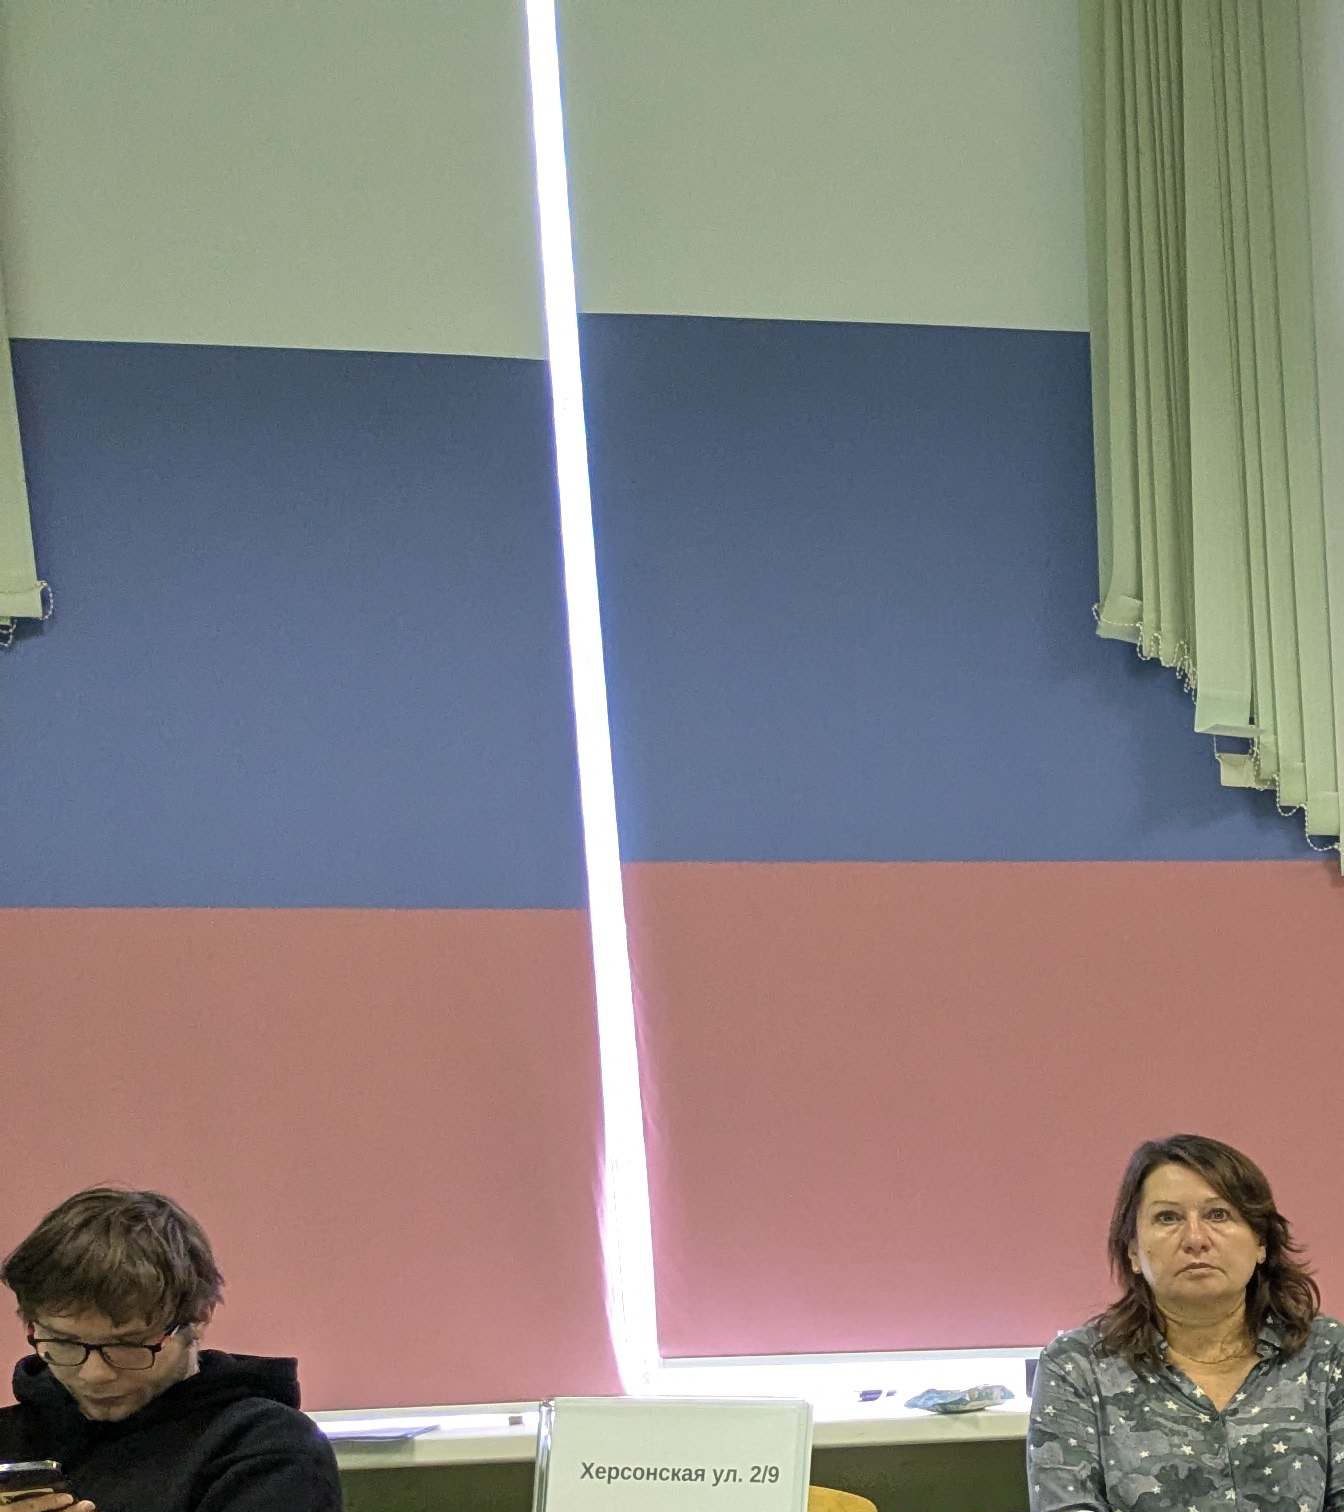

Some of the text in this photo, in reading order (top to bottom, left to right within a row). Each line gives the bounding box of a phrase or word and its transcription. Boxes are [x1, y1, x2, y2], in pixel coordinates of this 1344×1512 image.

[580, 1462, 780, 1486] Херсонская ул. 2/9
